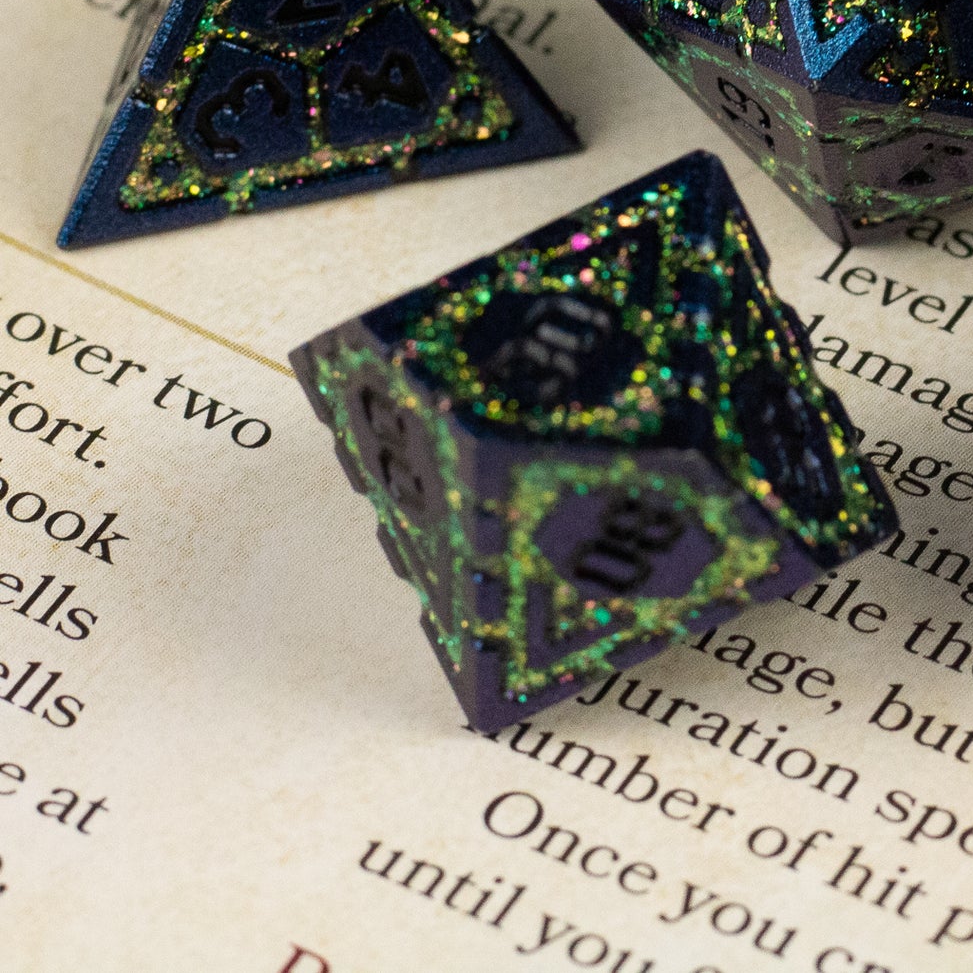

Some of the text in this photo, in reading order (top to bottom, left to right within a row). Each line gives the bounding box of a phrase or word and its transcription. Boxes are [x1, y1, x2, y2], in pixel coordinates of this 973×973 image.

[195, 70, 292, 159] 3
[334, 48, 431, 111] 4
[0, 371, 108, 470] fort.
[5, 311, 148, 388] over
[152, 373, 273, 450] two
[0, 478, 131, 565] ook
[783, 571, 888, 634] ile
[35, 786, 110, 836] at
[356, 838, 529, 929] until
[483, 790, 798, 958] Once you
[747, 823, 836, 873] of
[825, 844, 928, 921] hit
